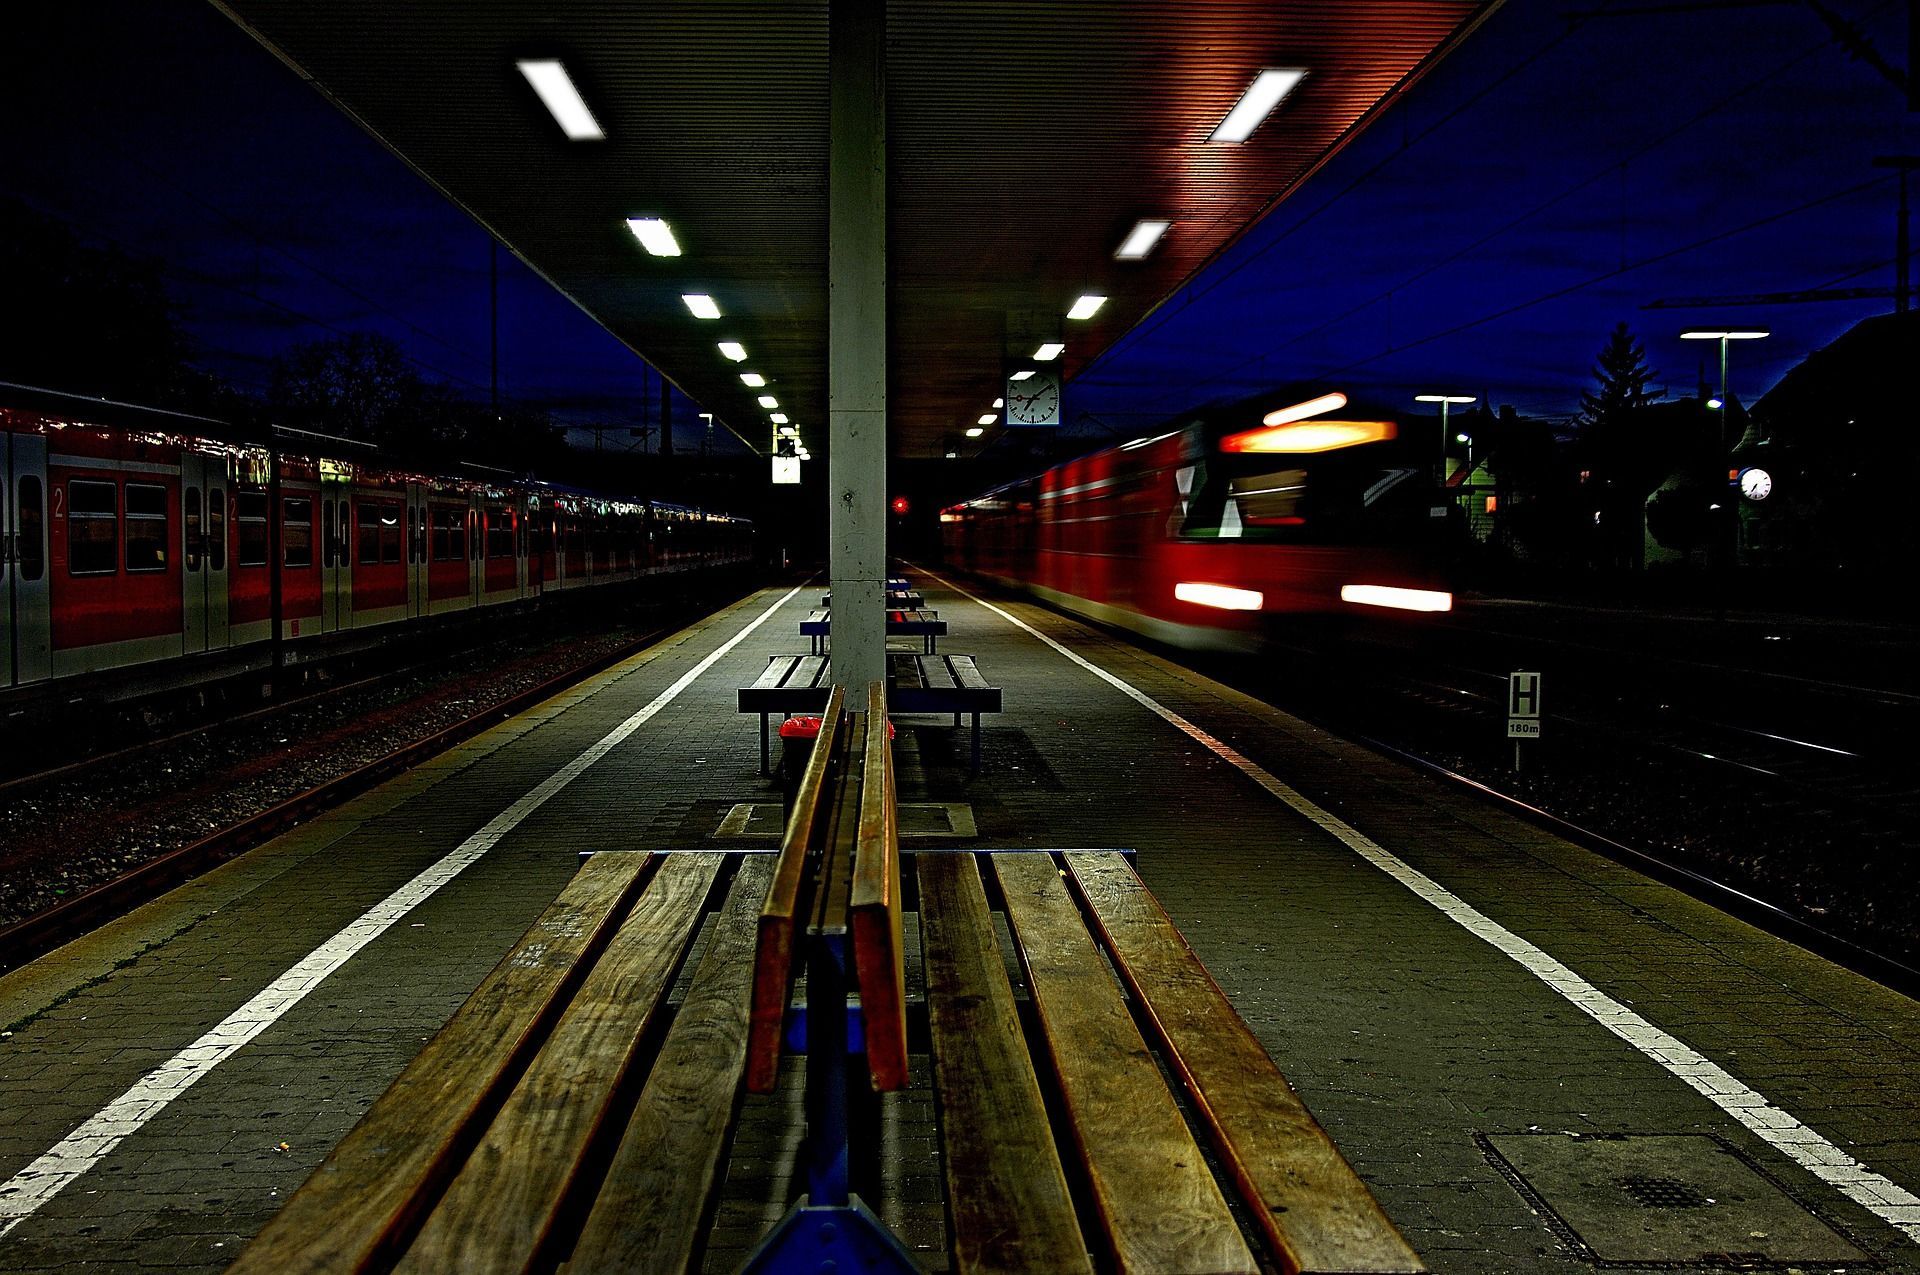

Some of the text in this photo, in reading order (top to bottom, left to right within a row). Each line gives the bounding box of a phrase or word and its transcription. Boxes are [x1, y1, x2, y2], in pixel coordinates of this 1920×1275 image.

[54, 487, 63, 518] 2
[1513, 676, 1537, 714] H
[1510, 723, 1539, 733] 180m
